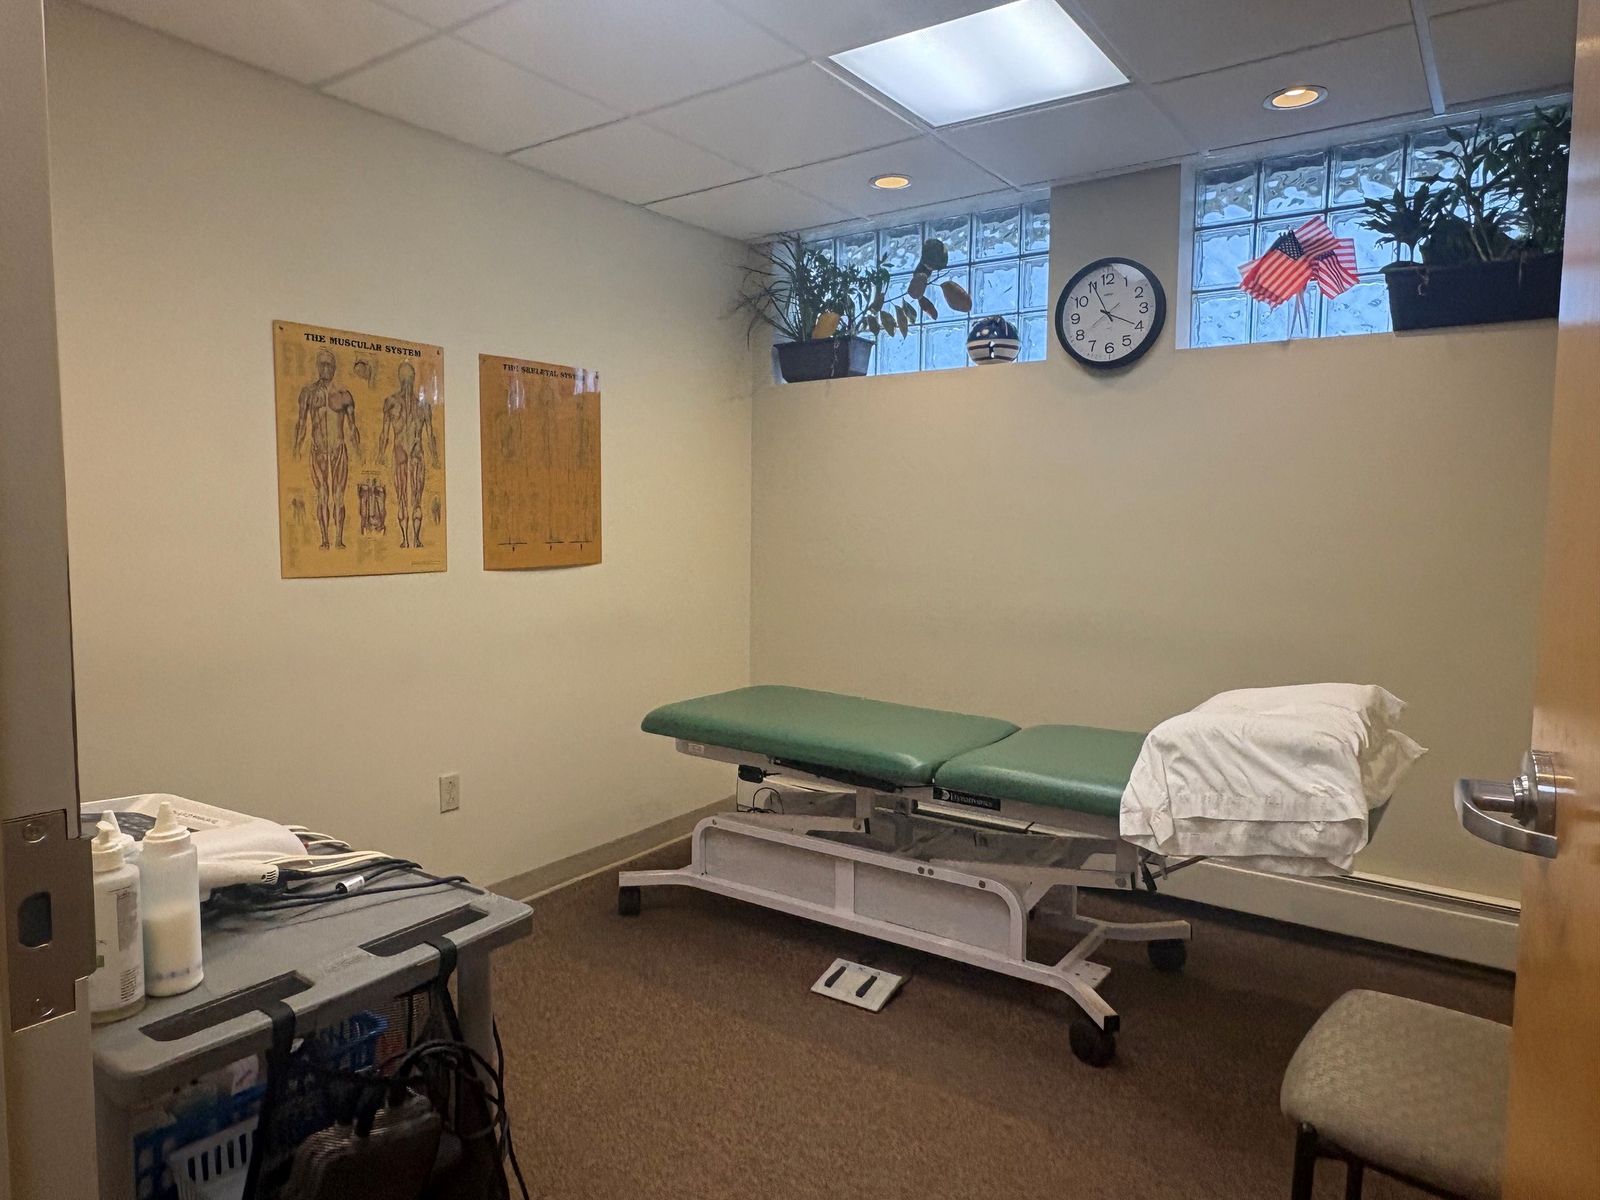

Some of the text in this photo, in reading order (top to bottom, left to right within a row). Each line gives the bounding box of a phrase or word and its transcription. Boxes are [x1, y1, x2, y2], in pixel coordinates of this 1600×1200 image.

[1101, 273, 1115, 286] 12
[1123, 276, 1128, 287] 1
[1088, 281, 1098, 294] 11
[1134, 286, 1144, 298] 2
[1074, 295, 1089, 309] 10
[1138, 301, 1149, 314] 3
[1070, 313, 1081, 325] 9
[1134, 320, 1144, 332] 4
[1075, 329, 1085, 341] 8
[1121, 334, 1132, 347] 5
[304, 333, 421, 358] THE MUSCULAR SYSTEM
[1088, 340, 1097, 352] 7
[1104, 342, 1115, 354] 6
[521, 366, 559, 378] SKELETAL
